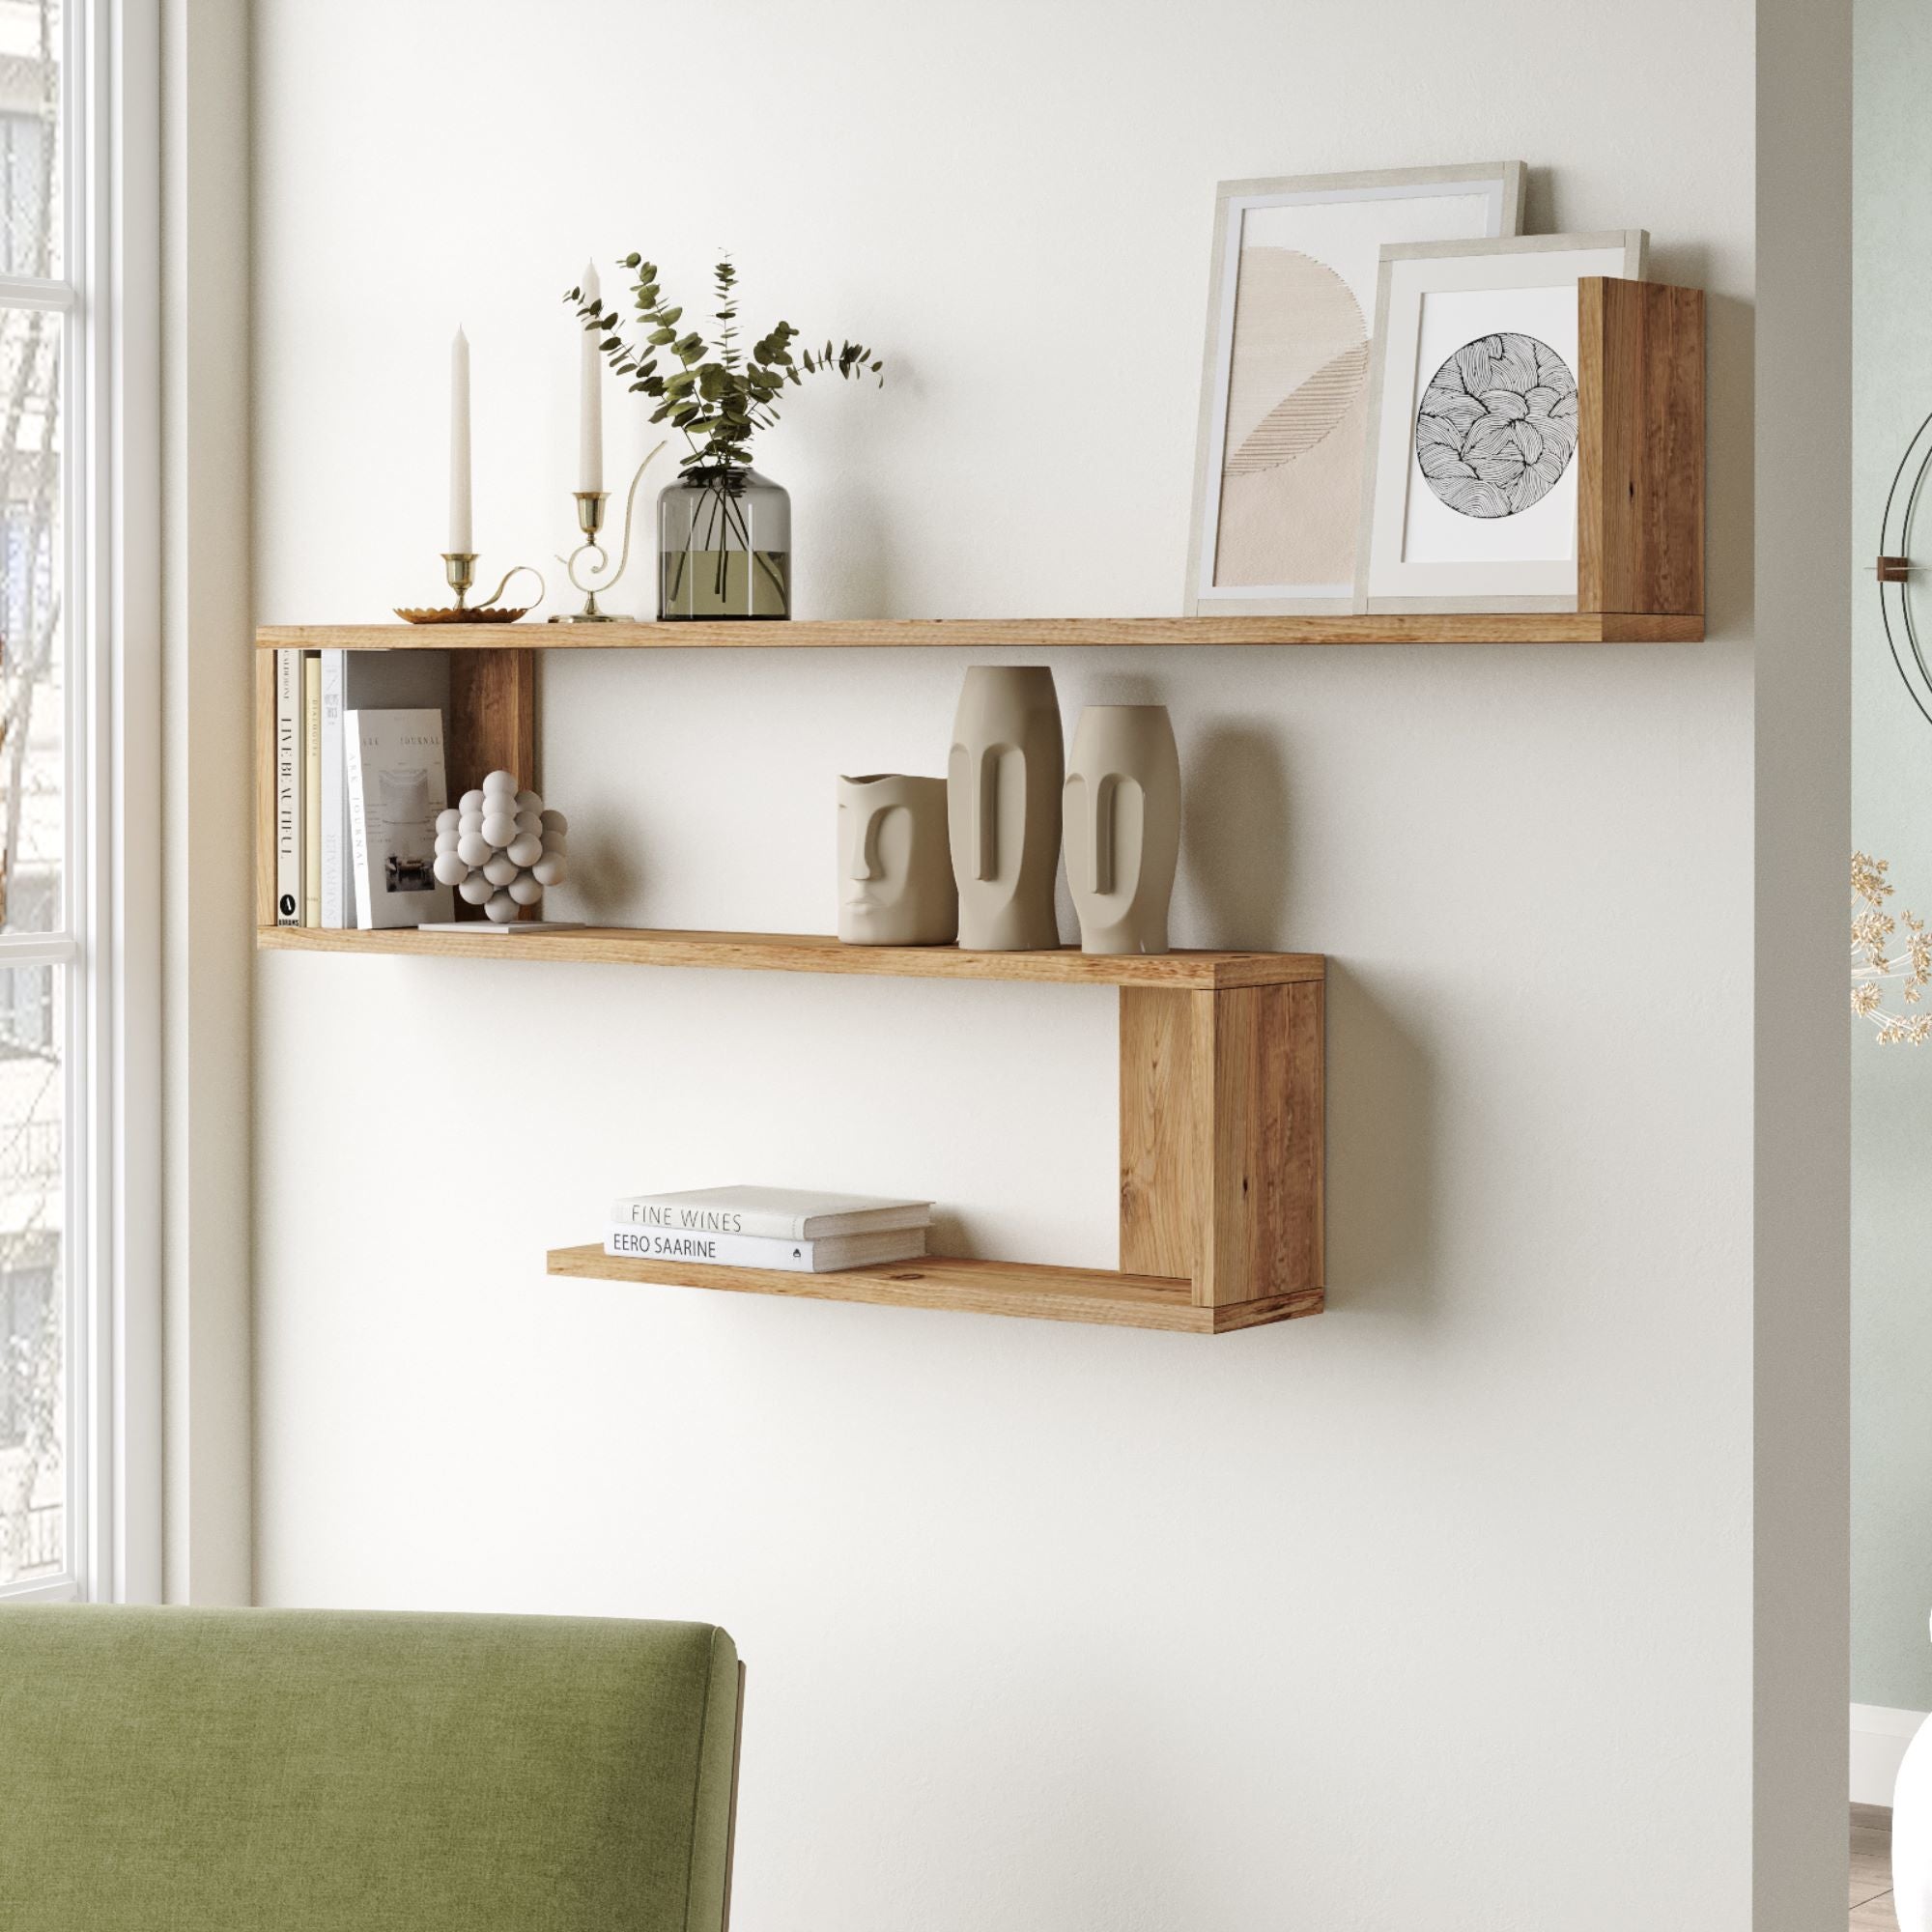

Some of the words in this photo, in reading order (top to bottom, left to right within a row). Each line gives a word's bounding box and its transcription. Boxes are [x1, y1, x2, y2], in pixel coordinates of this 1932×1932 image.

[281, 718, 292, 757] LIVE
[400, 736, 441, 746] JOURNAL
[349, 753, 358, 782] ARK
[281, 762, 292, 859] BEAUTIFUL
[352, 796, 364, 867] JOURNAL
[631, 1204, 673, 1226] FINE
[680, 1208, 743, 1233] WINES
[612, 1233, 650, 1254] EERO
[654, 1236, 717, 1259] SAARINE
